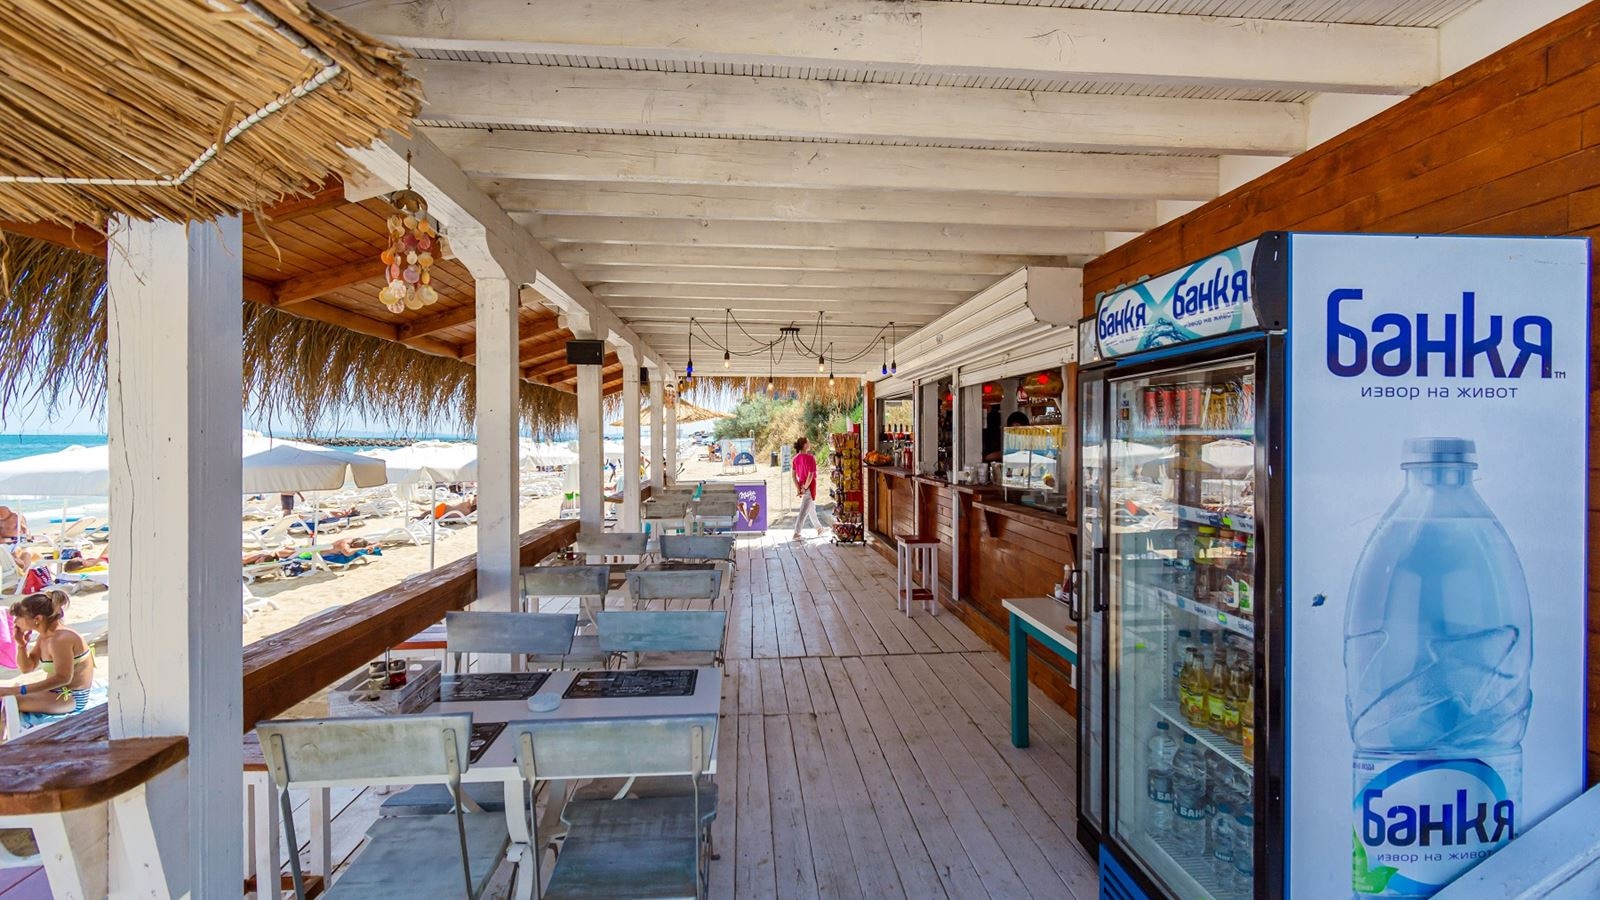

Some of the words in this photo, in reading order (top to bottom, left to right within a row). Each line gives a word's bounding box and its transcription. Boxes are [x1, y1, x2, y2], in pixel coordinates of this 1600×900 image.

[1361, 386, 1420, 400] извор
[1427, 386, 1449, 398] на
[1457, 386, 1518, 399] живот
[1377, 853, 1418, 863] извор
[1424, 853, 1442, 861] на
